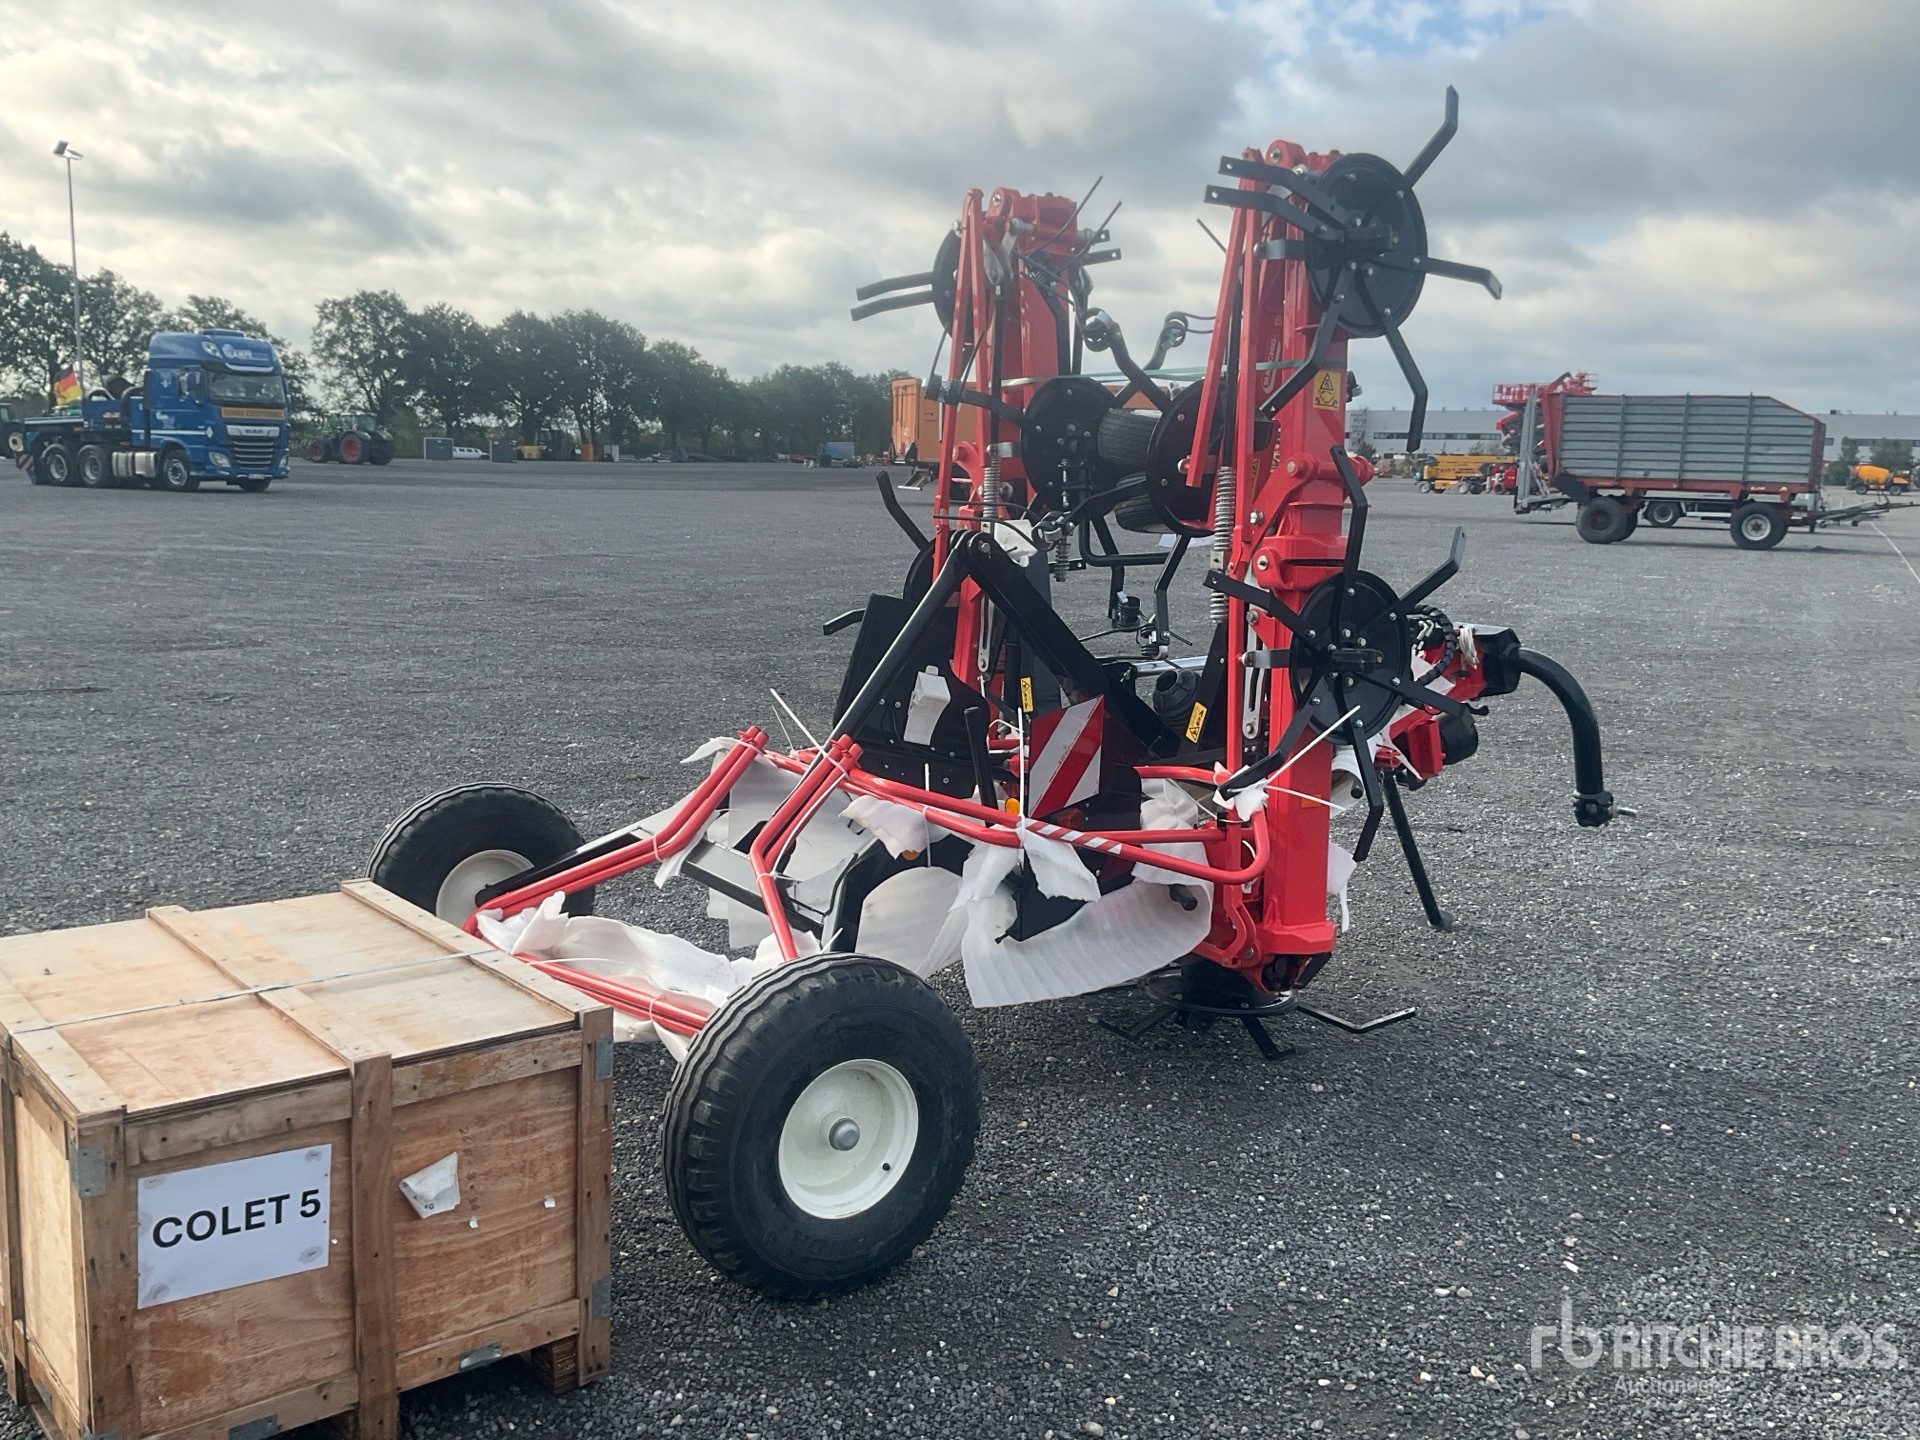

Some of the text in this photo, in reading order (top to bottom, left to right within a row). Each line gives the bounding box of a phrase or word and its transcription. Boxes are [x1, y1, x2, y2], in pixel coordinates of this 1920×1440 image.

[1263, 338, 1277, 386] MACHIO
[152, 1188, 321, 1248] COLET 5
